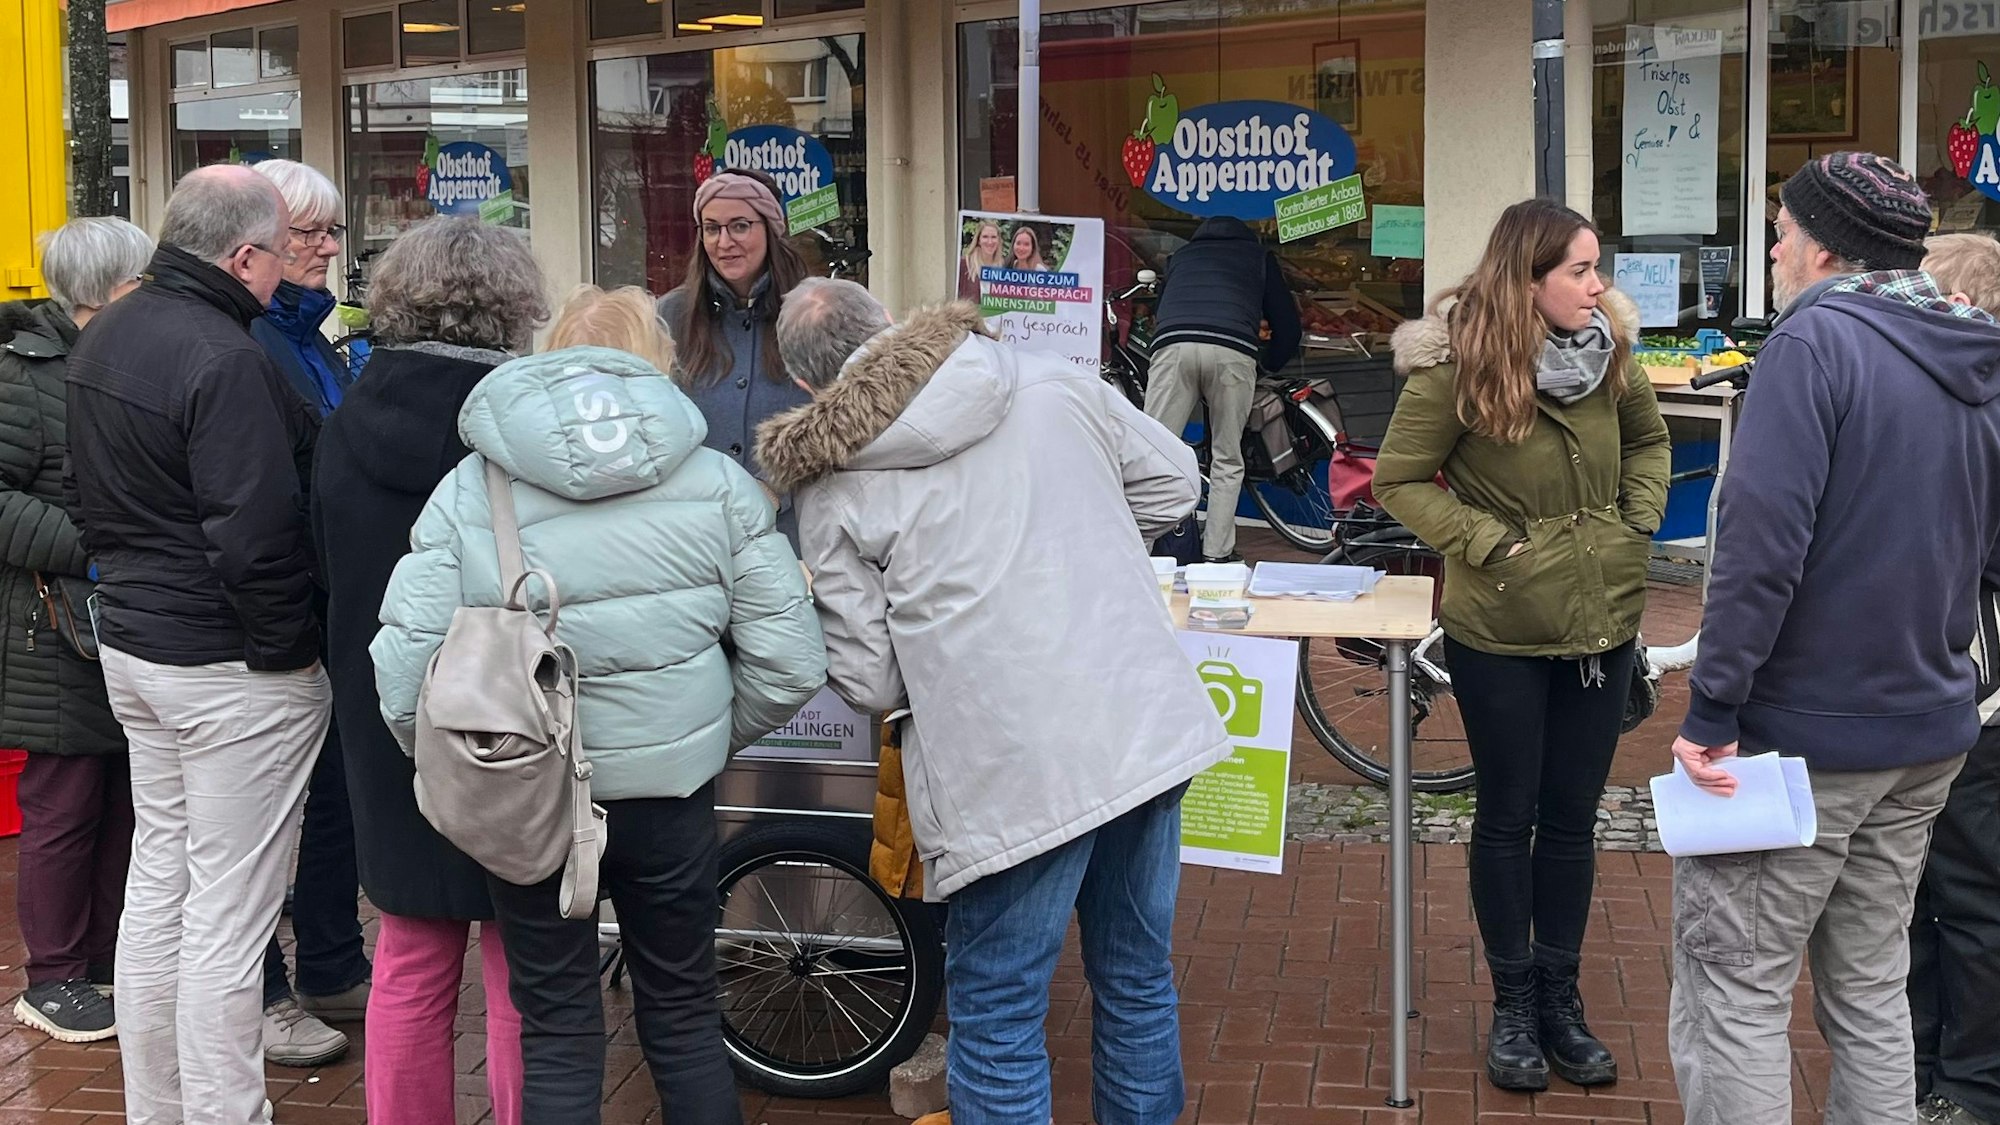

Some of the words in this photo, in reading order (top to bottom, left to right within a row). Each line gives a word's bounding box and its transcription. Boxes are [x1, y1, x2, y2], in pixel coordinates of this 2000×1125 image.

[1637, 46, 1690, 90] Frisches
[1657, 90, 1686, 116] Obst
[1689, 113, 1701, 139] &
[1173, 112, 1310, 159] Obsthof
[436, 151, 491, 178] Obsthof
[724, 136, 806, 170] Obsthof
[1975, 143, 2000, 188] A
[428, 173, 501, 206] Appenrodt
[1151, 149, 1334, 202] Appenrodt
[1277, 194, 1328, 219] Kontrollierter
[1330, 184, 1360, 203] Anbau
[1280, 216, 1325, 239] Obstanbau
[1326, 211, 1340, 226] seit
[1342, 202, 1363, 221] 1887
[982, 269, 1045, 285] EINLADUNG
[1047, 274, 1075, 286] ZUM
[1644, 259, 1675, 285] NEU!
[983, 297, 1052, 311] INNENSTADT
[991, 284, 1089, 300] MARKTGESPRÄCH
[1000, 315, 1014, 329] Im
[1021, 315, 1088, 340] Gespräch
[774, 722, 854, 738] CHLINGEN
